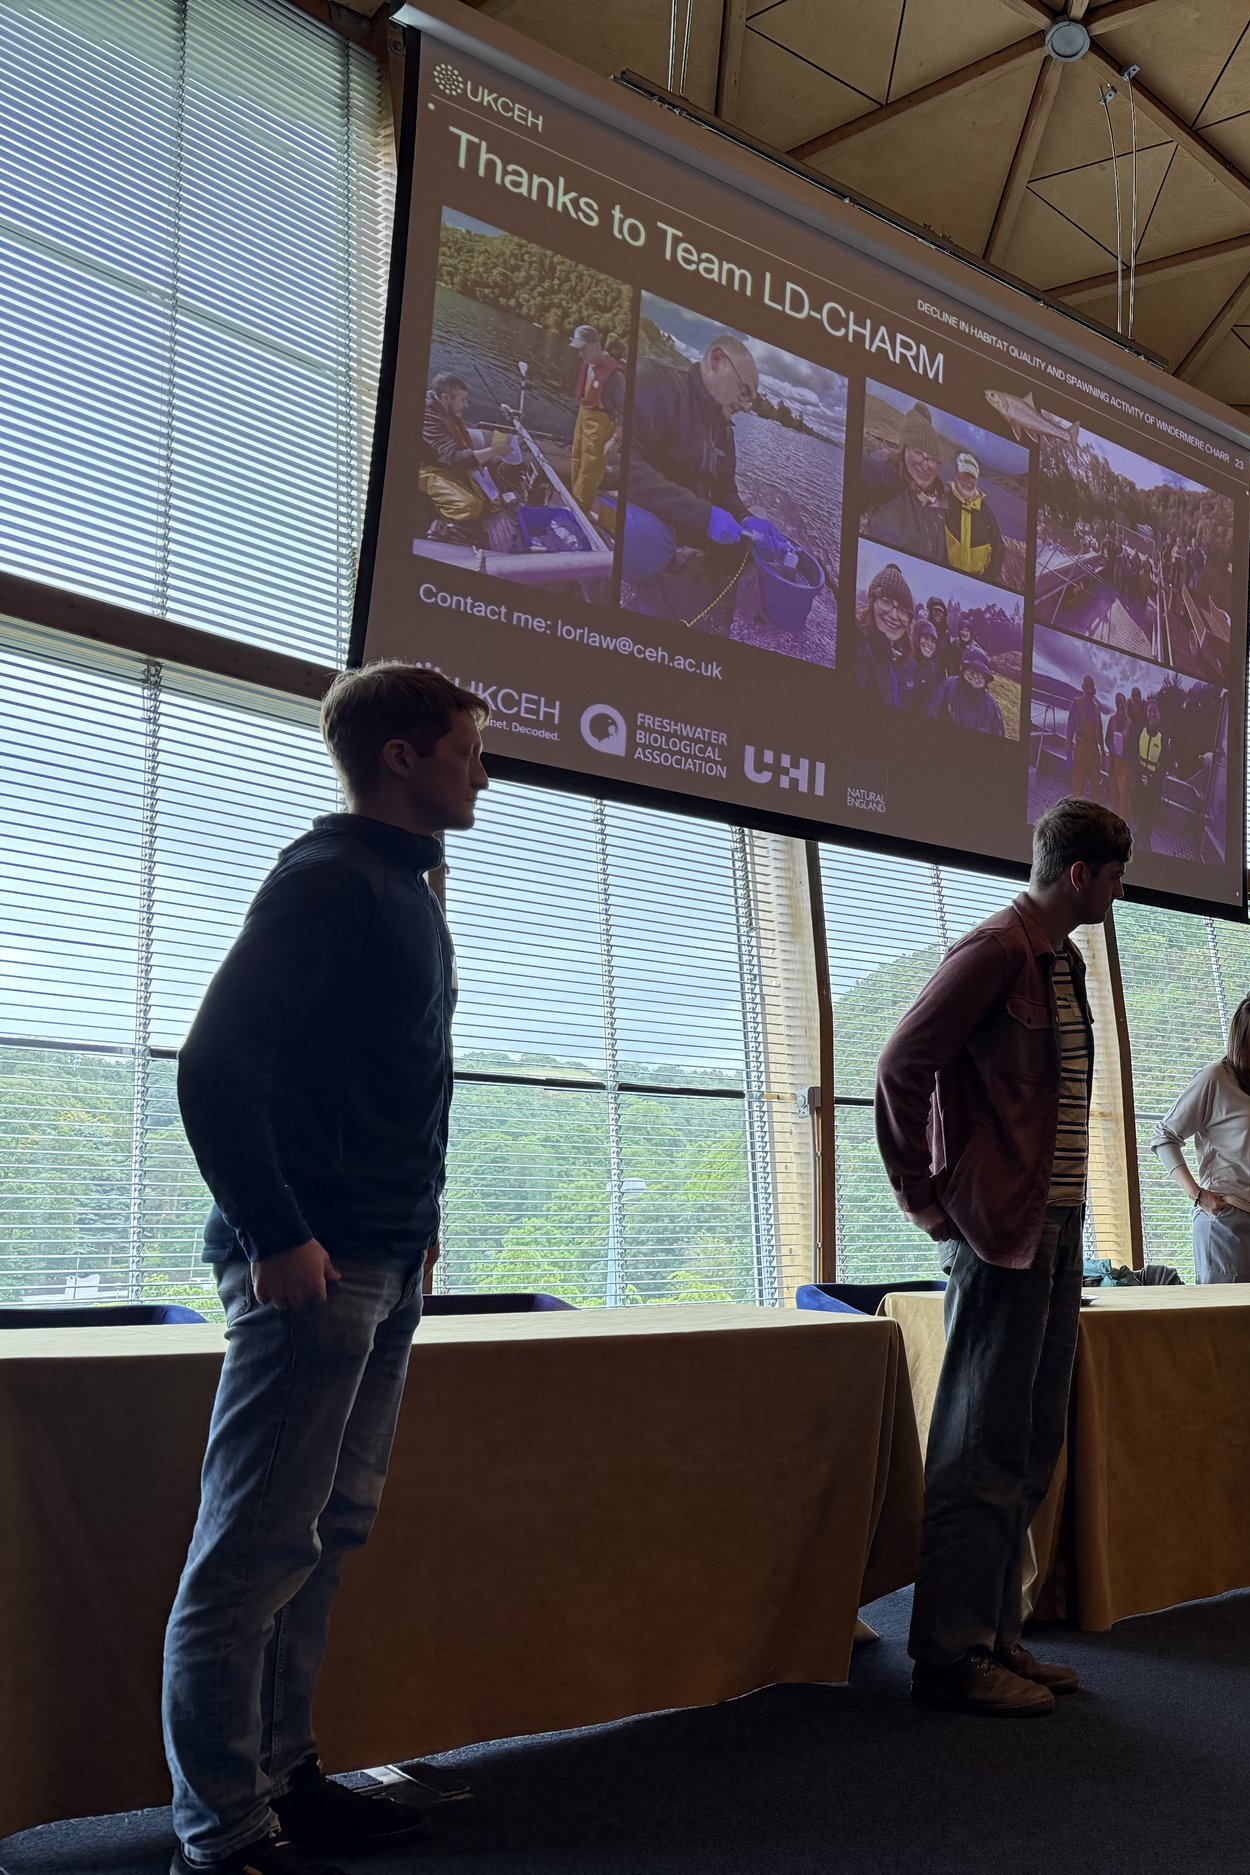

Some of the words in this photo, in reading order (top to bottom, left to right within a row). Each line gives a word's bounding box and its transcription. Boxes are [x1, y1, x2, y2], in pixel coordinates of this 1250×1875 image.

[466, 80, 544, 133] UKCEH
[448, 125, 600, 228] Thanks
[610, 203, 647, 248] to
[656, 221, 753, 298] Team
[763, 271, 945, 385] LD-CHARM
[917, 299, 959, 329] DECLINE
[959, 320, 970, 334] IN
[970, 325, 1009, 353] HABITAT
[1008, 345, 1047, 372] QUALITY
[1046, 364, 1066, 381] AND
[1065, 373, 1110, 403] SPAWNING
[1110, 396, 1145, 421] ACTIVITY
[1144, 412, 1157, 425] OF
[1156, 419, 1205, 451] WINDERMERE
[1204, 443, 1231, 464] CHARR
[1234, 458, 1245, 471] 23
[418, 583, 507, 623] Contact
[512, 610, 552, 634] me:
[557, 619, 723, 681] lorlaw@ceh.ac.uk
[511, 721, 561, 742] Decoded.
[635, 729, 723, 762] BIOLOGICAL
[636, 712, 728, 747] FRESHWATER
[633, 746, 728, 779] ASSOCIATION
[743, 744, 826, 797] UHI
[846, 795, 887, 813] ENGLAND
[847, 786, 886, 804] NATURAL
